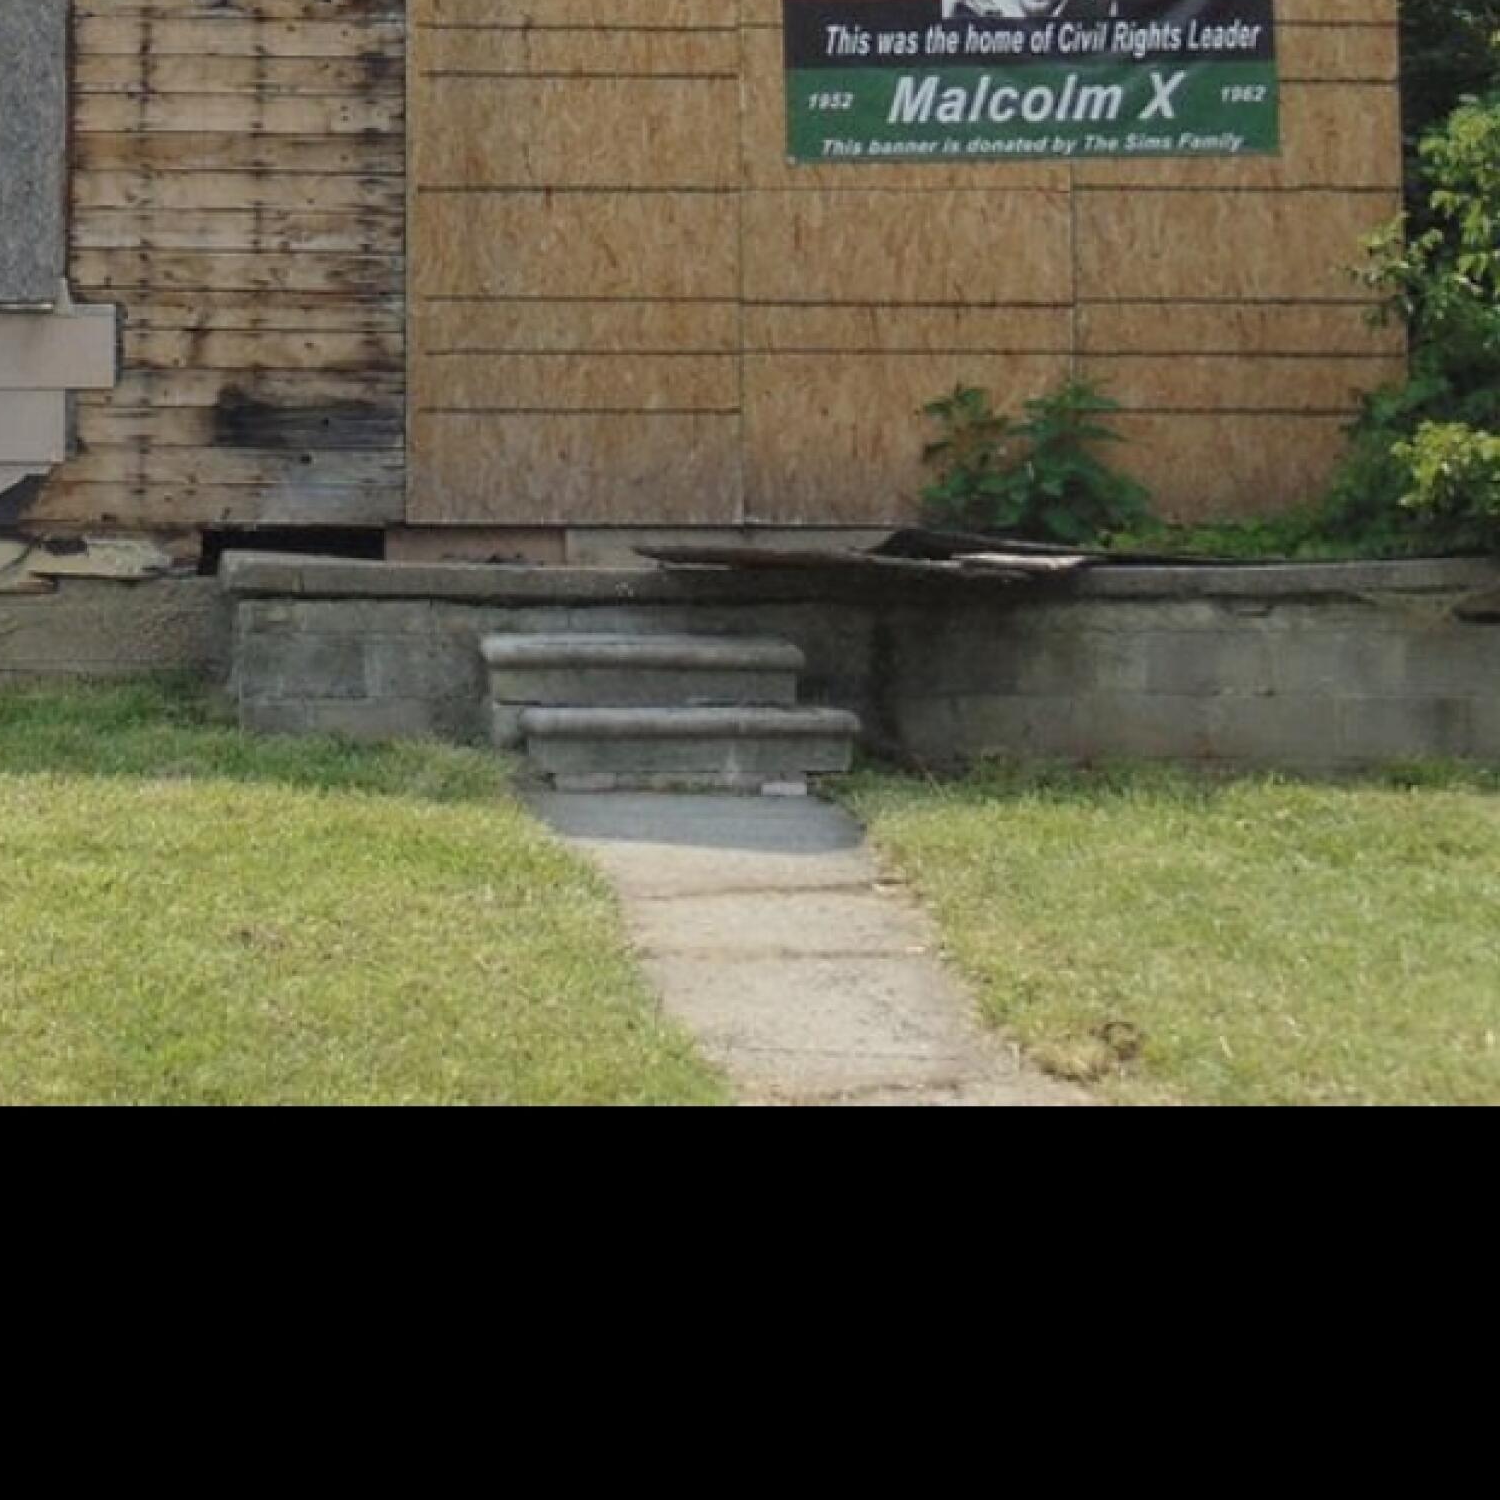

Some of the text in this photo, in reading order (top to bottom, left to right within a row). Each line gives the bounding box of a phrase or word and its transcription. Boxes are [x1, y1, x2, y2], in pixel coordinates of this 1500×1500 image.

[825, 19, 1262, 59] This was the home of Civil Rights Leader
[887, 70, 1188, 124] Malcolm X
[822, 139, 863, 156] This
[868, 138, 937, 155] banner
[942, 137, 961, 154] is
[966, 137, 1047, 153] donated
[1052, 135, 1076, 155] by
[1083, 134, 1119, 151] The
[1178, 132, 1244, 153] Family
